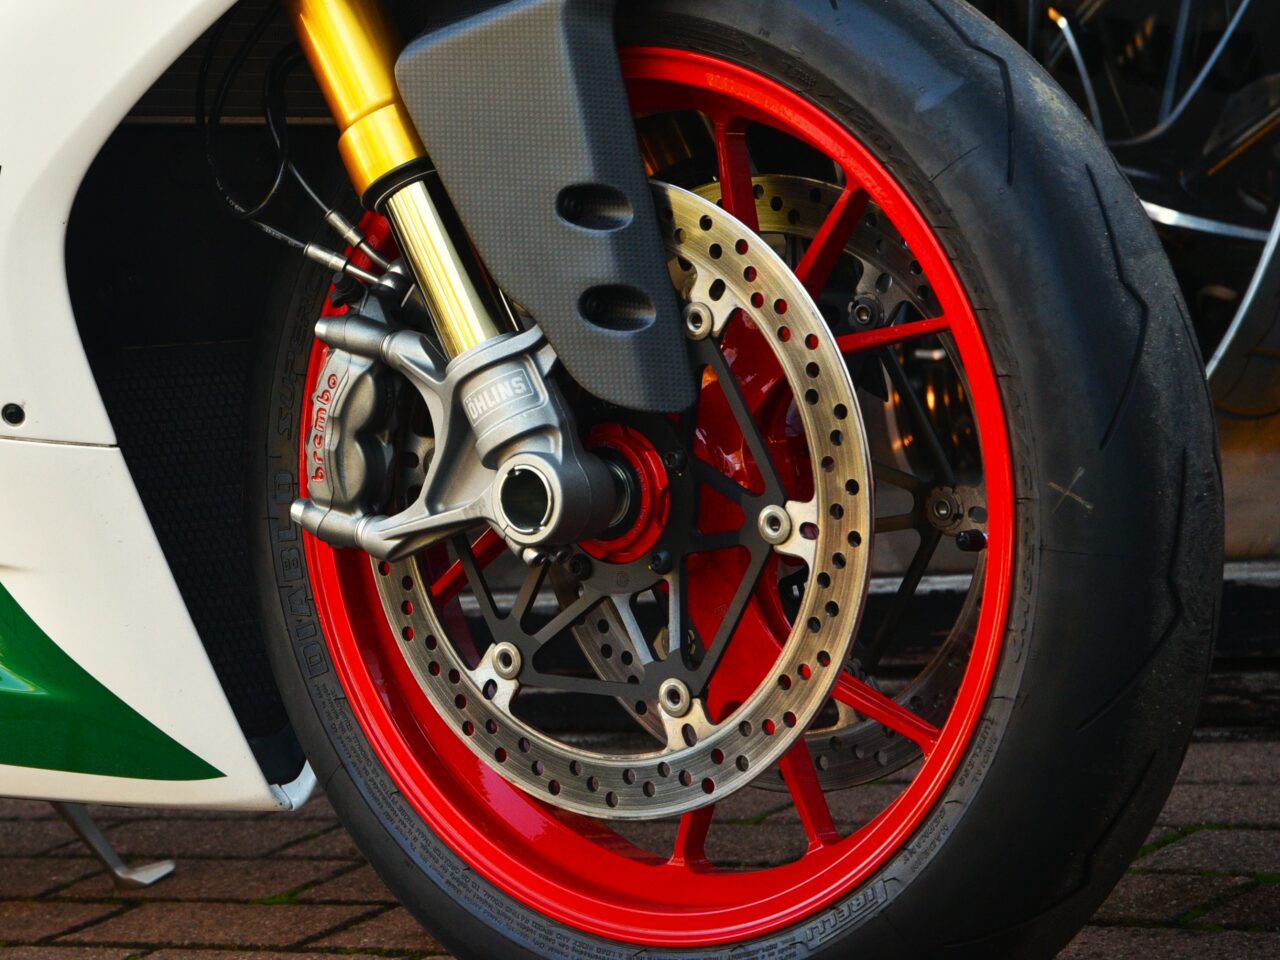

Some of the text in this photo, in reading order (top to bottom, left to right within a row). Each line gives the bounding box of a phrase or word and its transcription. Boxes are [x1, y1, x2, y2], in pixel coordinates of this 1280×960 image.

[311, 373, 338, 483] brembo
[466, 374, 526, 421] ÖHLINS
[271, 471, 329, 681] DIABLO
[802, 877, 891, 951] PIRELLI
